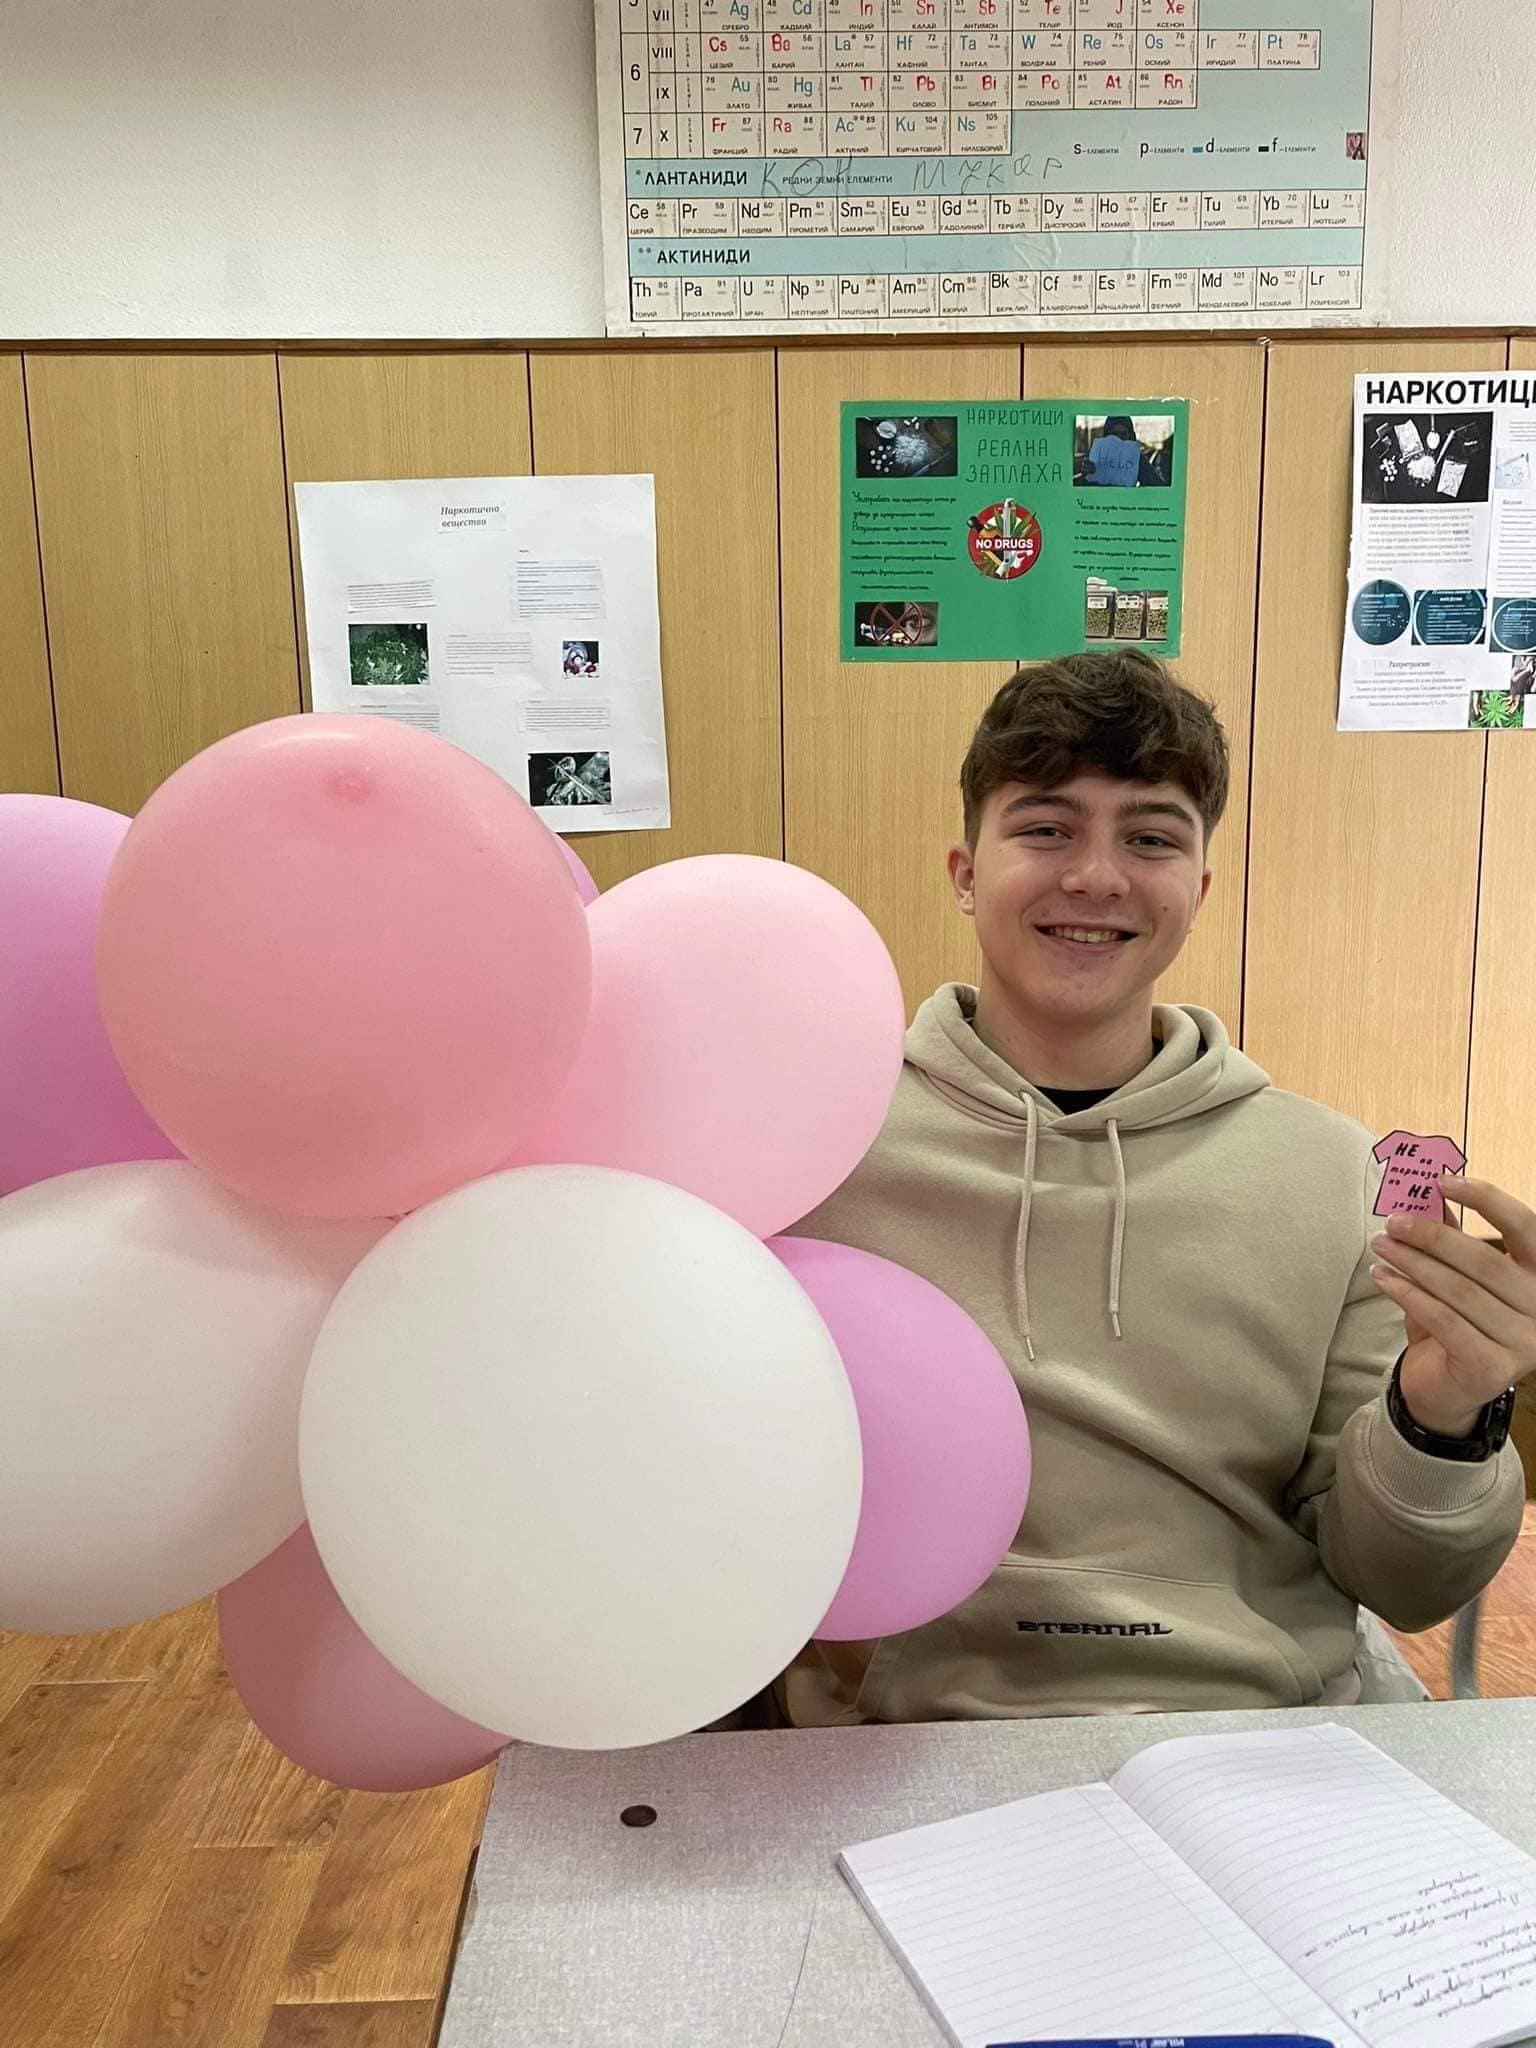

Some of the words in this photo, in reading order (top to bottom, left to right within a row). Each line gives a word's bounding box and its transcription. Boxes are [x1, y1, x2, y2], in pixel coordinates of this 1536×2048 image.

[730, 0, 748, 20] Ag
[793, 0, 812, 15] Cd
[860, 1, 873, 16] In
[916, 0, 935, 15] Sn
[979, 0, 996, 15] Sb
[1045, 0, 1060, 14] Te
[1167, 0, 1184, 14] Xe
[653, 10, 669, 21] VII
[709, 37, 727, 52] Cs
[897, 35, 912, 50] Hf
[960, 35, 976, 50] Ta
[1022, 35, 1036, 49] W
[1083, 34, 1101, 49] Re
[1145, 34, 1163, 49] Os
[1206, 34, 1216, 49] Ir
[1268, 34, 1282, 49] Pt
[652, 48, 672, 58] VIII
[630, 64, 640, 81] 6
[732, 77, 750, 92] Au
[794, 77, 812, 96] Hg
[916, 75, 935, 91] Pb
[982, 75, 996, 90] Bi
[1042, 75, 1060, 89] Po
[1106, 75, 1121, 88] At
[1164, 74, 1182, 88] Rn
[656, 88, 670, 99] IX
[712, 118, 726, 132] Fr
[773, 118, 791, 132] Ra
[836, 117, 854, 132] Ac
[896, 116, 915, 132] Ku
[958, 116, 976, 131] Ns
[633, 128, 642, 144] 7
[660, 130, 668, 142] X
[841, 202, 862, 217] Sm
[892, 201, 909, 216] Eu
[942, 200, 961, 216] Gd
[994, 200, 1011, 214] Tb
[1044, 199, 1064, 218] Dy
[1100, 198, 1118, 213] Ho
[1153, 198, 1168, 212] Er
[1204, 197, 1220, 211] Tu
[1263, 196, 1279, 211] Yb
[1313, 195, 1329, 209] Lu
[630, 204, 648, 219] Ce
[682, 204, 697, 218] Pr
[742, 203, 759, 218] Nd
[790, 203, 811, 218] Pm
[658, 249, 750, 264] АКТИНИДИ
[943, 278, 964, 293] Cm
[992, 274, 1009, 288] Bk
[1044, 276, 1059, 291] Cf
[1099, 276, 1115, 289] Es
[1152, 274, 1171, 288] Fm
[1202, 273, 1222, 288] Md
[1260, 272, 1278, 286] No
[1311, 272, 1324, 285] Lr
[634, 282, 651, 297] Th
[685, 282, 702, 296] Pa
[744, 281, 752, 296] U
[791, 280, 809, 300] Np
[841, 280, 859, 295] Pu
[893, 280, 916, 294] Am
[1367, 380, 1536, 408] НАРКОТИЦ
[968, 408, 1063, 425] НАРКОТИЦИ
[978, 438, 1047, 456] РЕАЛНА
[966, 464, 1062, 483] ЗАПЛАХА
[441, 506, 499, 516] Наркотично
[976, 540, 992, 548] NO
[995, 539, 1033, 548] DRUGS
[1395, 1143, 1419, 1157] НЕ
[1408, 1184, 1432, 1199] НЕ
[1017, 1621, 1173, 1636] ETERNAL
